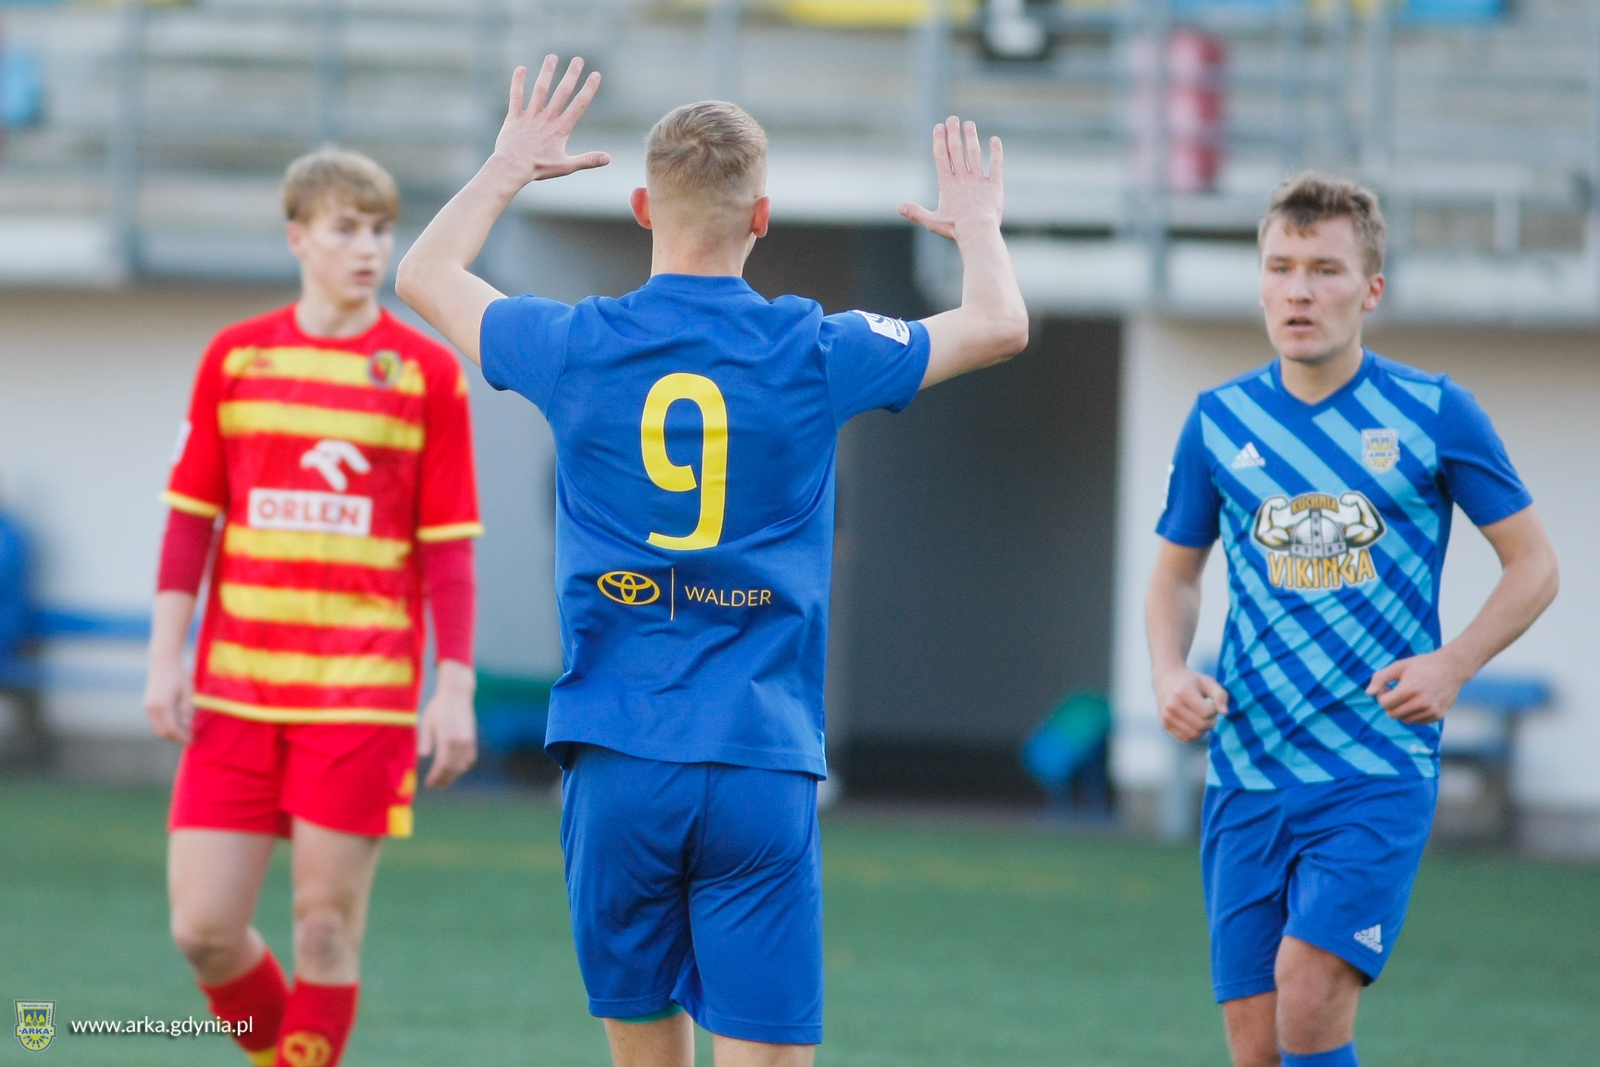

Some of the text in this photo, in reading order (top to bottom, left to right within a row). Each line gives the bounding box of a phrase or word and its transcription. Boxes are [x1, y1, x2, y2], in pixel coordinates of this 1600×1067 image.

[641, 372, 728, 550] 9
[257, 498, 361, 526] ORLEN
[1291, 495, 1339, 515] KUCHNIA
[1268, 550, 1375, 589] VIKINGA
[684, 586, 772, 607] WALDER
